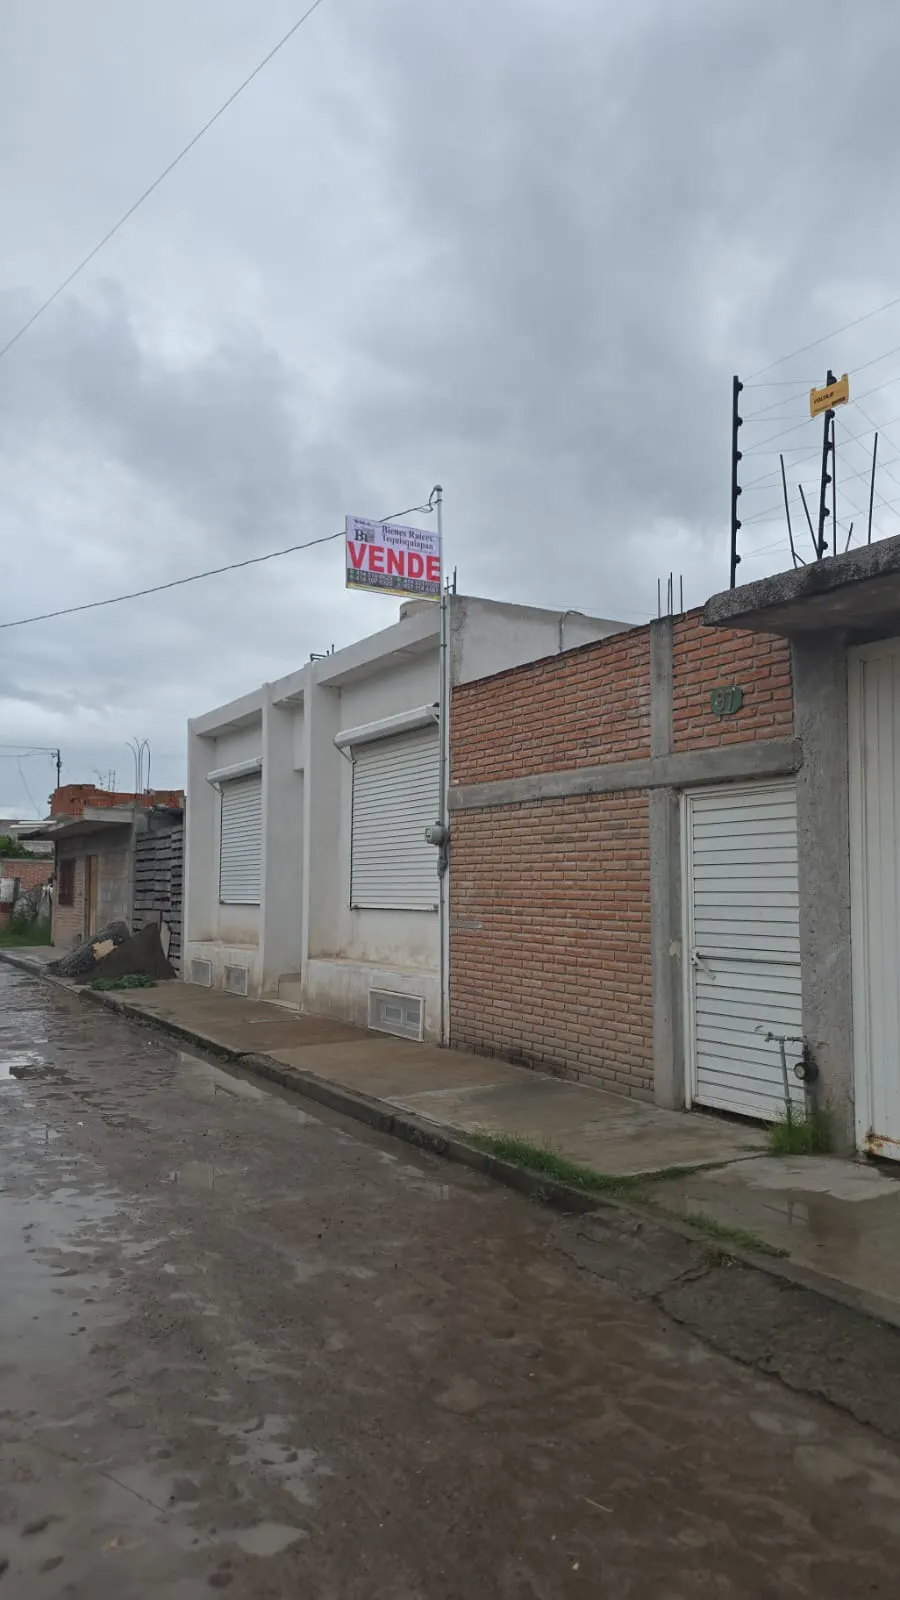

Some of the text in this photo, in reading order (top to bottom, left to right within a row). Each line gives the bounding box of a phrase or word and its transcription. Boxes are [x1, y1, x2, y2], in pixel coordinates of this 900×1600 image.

[382, 525, 407, 538] Bienes
[382, 533, 434, 551] Tequisquiapan
[347, 541, 440, 582] VENDE
